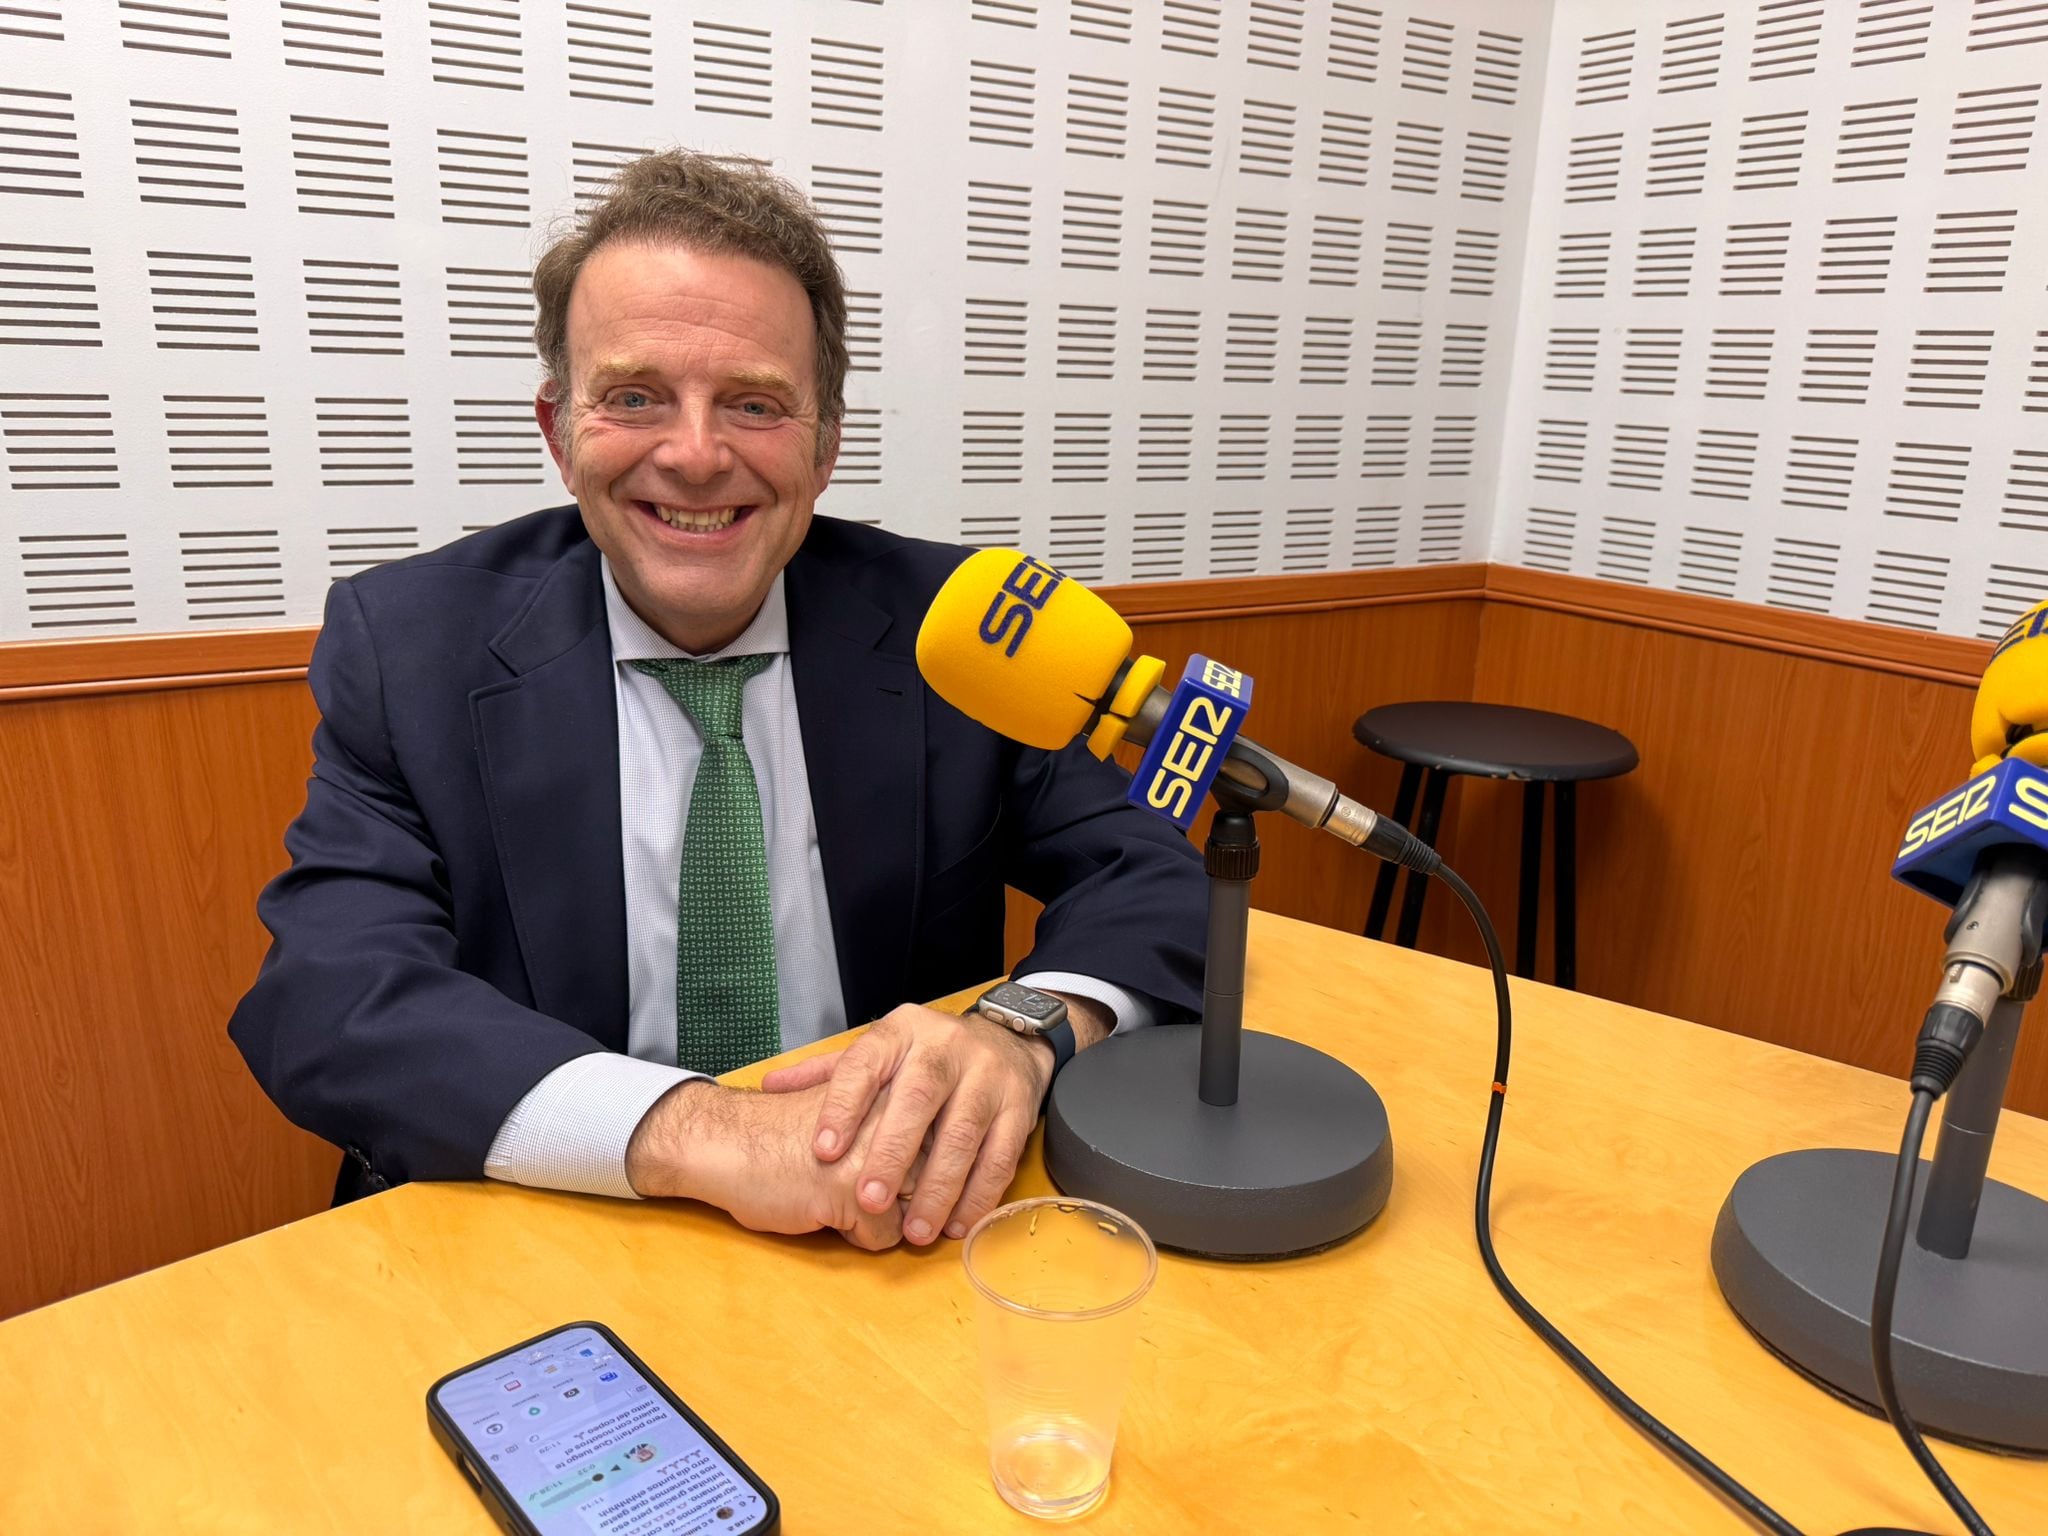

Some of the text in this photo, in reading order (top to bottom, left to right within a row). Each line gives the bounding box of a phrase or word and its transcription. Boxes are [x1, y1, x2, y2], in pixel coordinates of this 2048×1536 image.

[1147, 697, 1232, 819] SER
[1898, 775, 1996, 859] SER
[587, 1400, 654, 1434] ratito del copeo
[646, 1412, 667, 1425] Pero
[564, 1406, 660, 1456] quiero con nosotros el
[593, 1439, 613, 1450] Que
[566, 1448, 593, 1464] luego
[691, 1456, 710, 1468] otro
[646, 1473, 677, 1492] juntos
[687, 1471, 725, 1492] Infinitas
[688, 1478, 732, 1502] hermano.
[599, 1463, 717, 1528] nos lo tenemos que gastar
[653, 1489, 687, 1510] gracias
[676, 1485, 738, 1520] agradecemos
[630, 1507, 653, 1522] pero
[663, 1518, 676, 1528] de
[611, 1521, 630, 1533] eso
